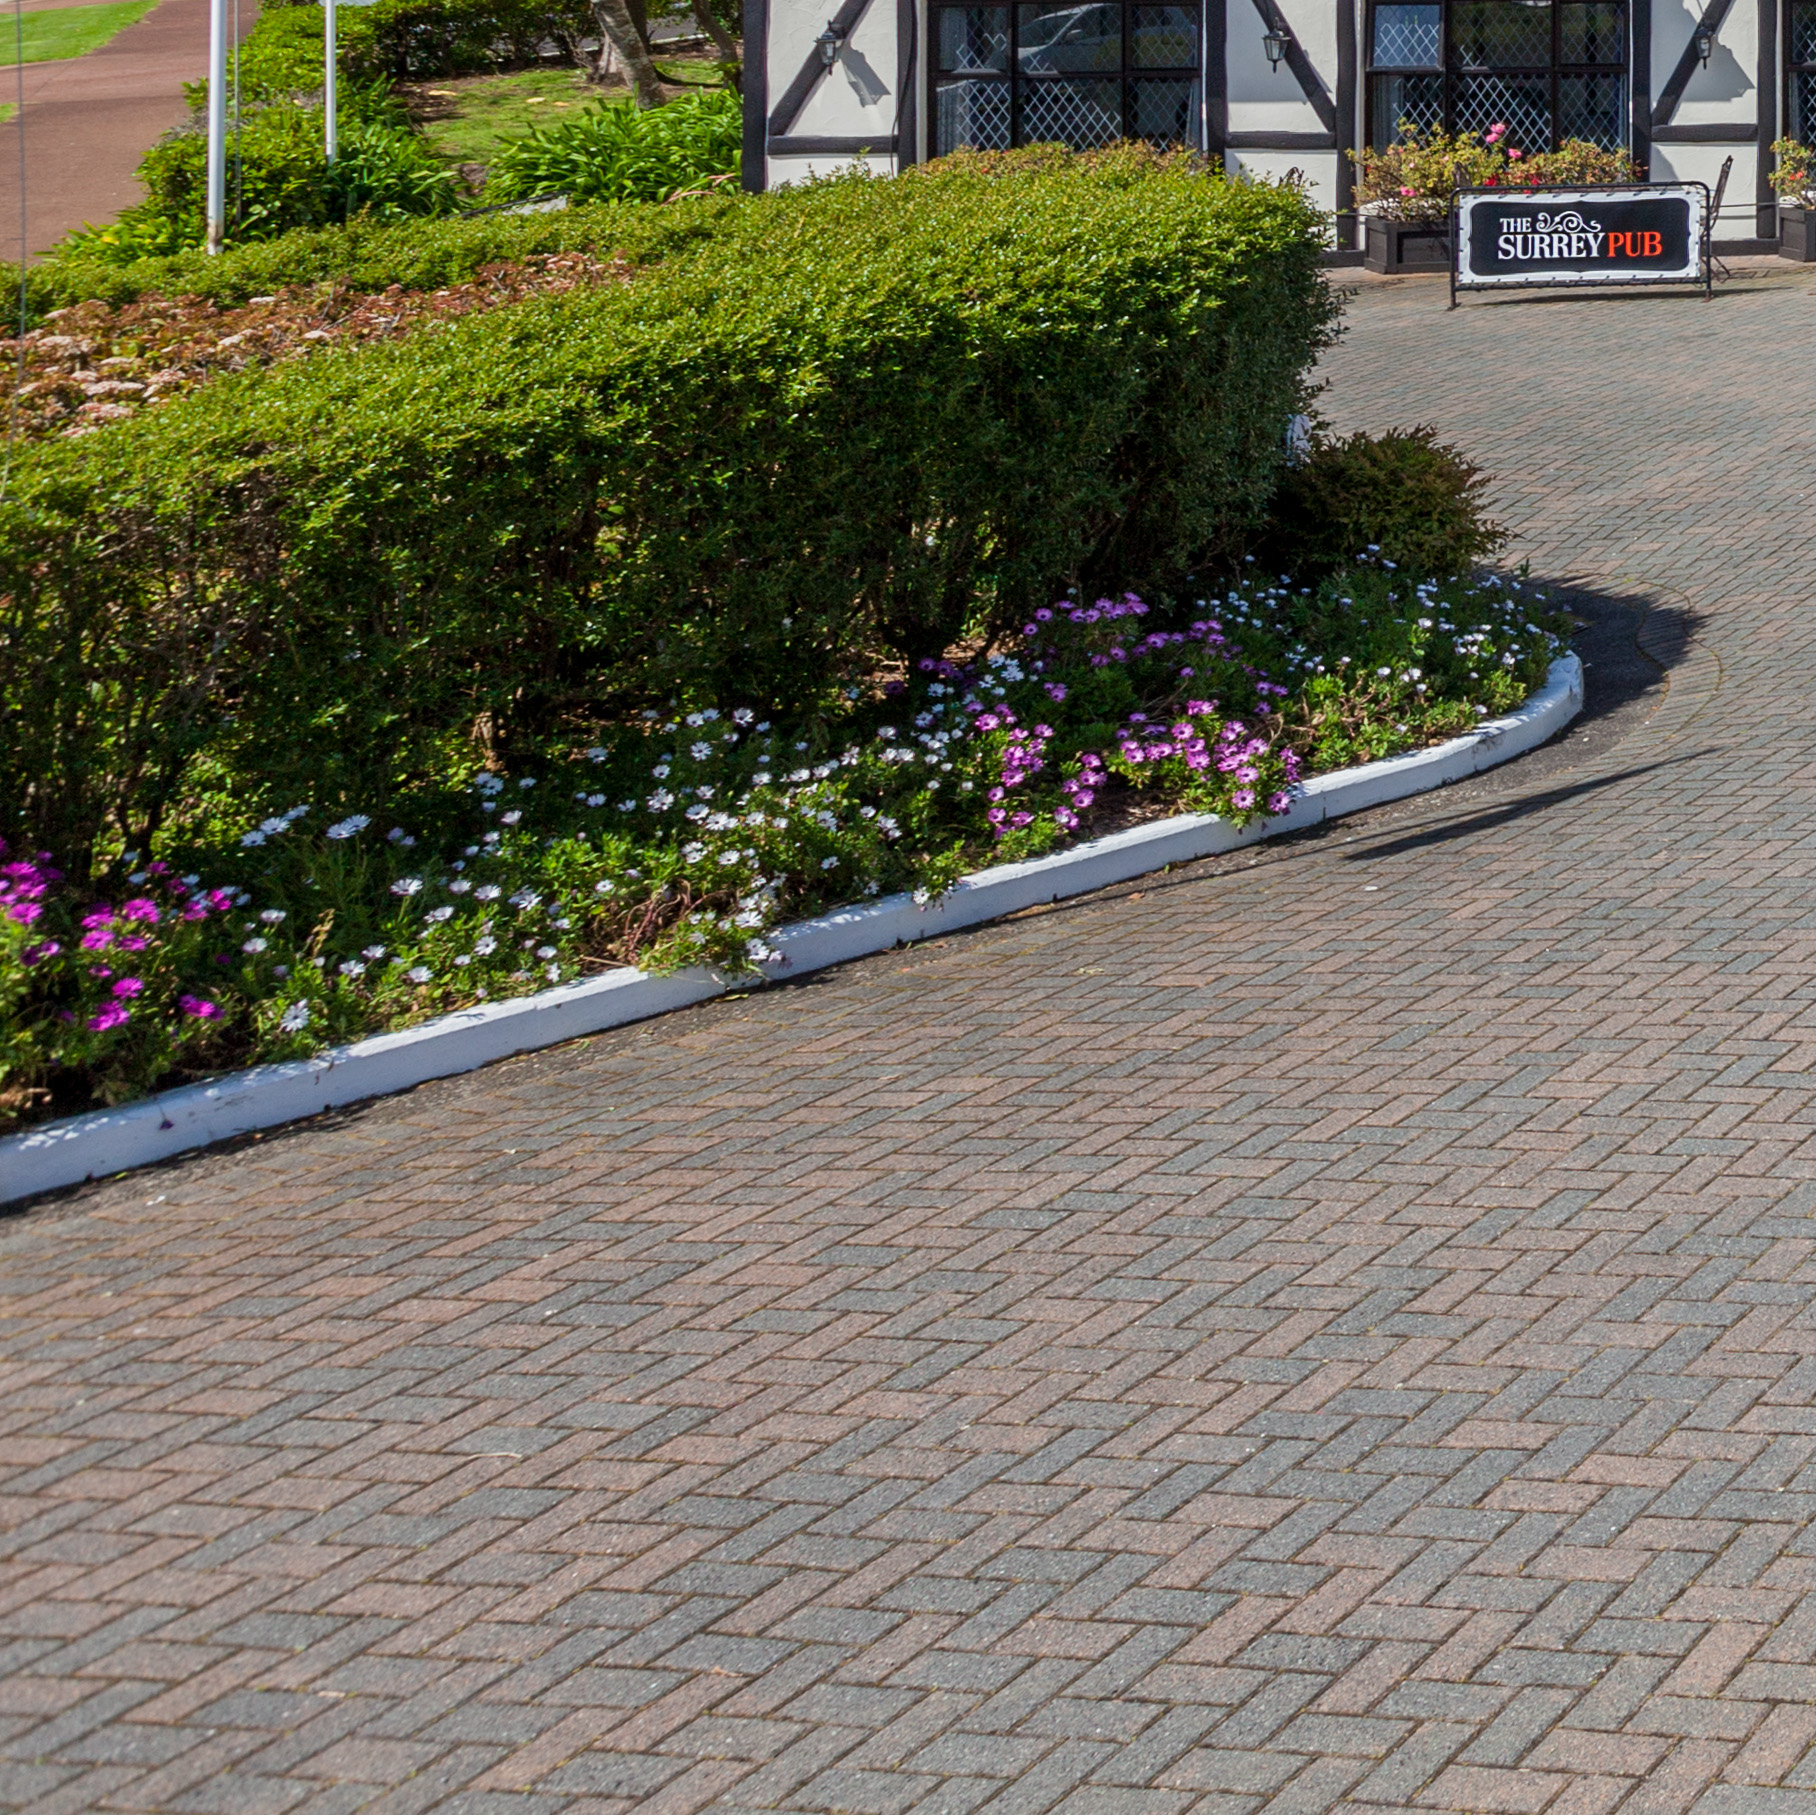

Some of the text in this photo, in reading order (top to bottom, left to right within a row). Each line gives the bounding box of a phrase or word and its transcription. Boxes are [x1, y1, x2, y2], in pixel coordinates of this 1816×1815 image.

[1500, 218, 1532, 232] THE
[1498, 231, 1663, 260] SURREY PUB
